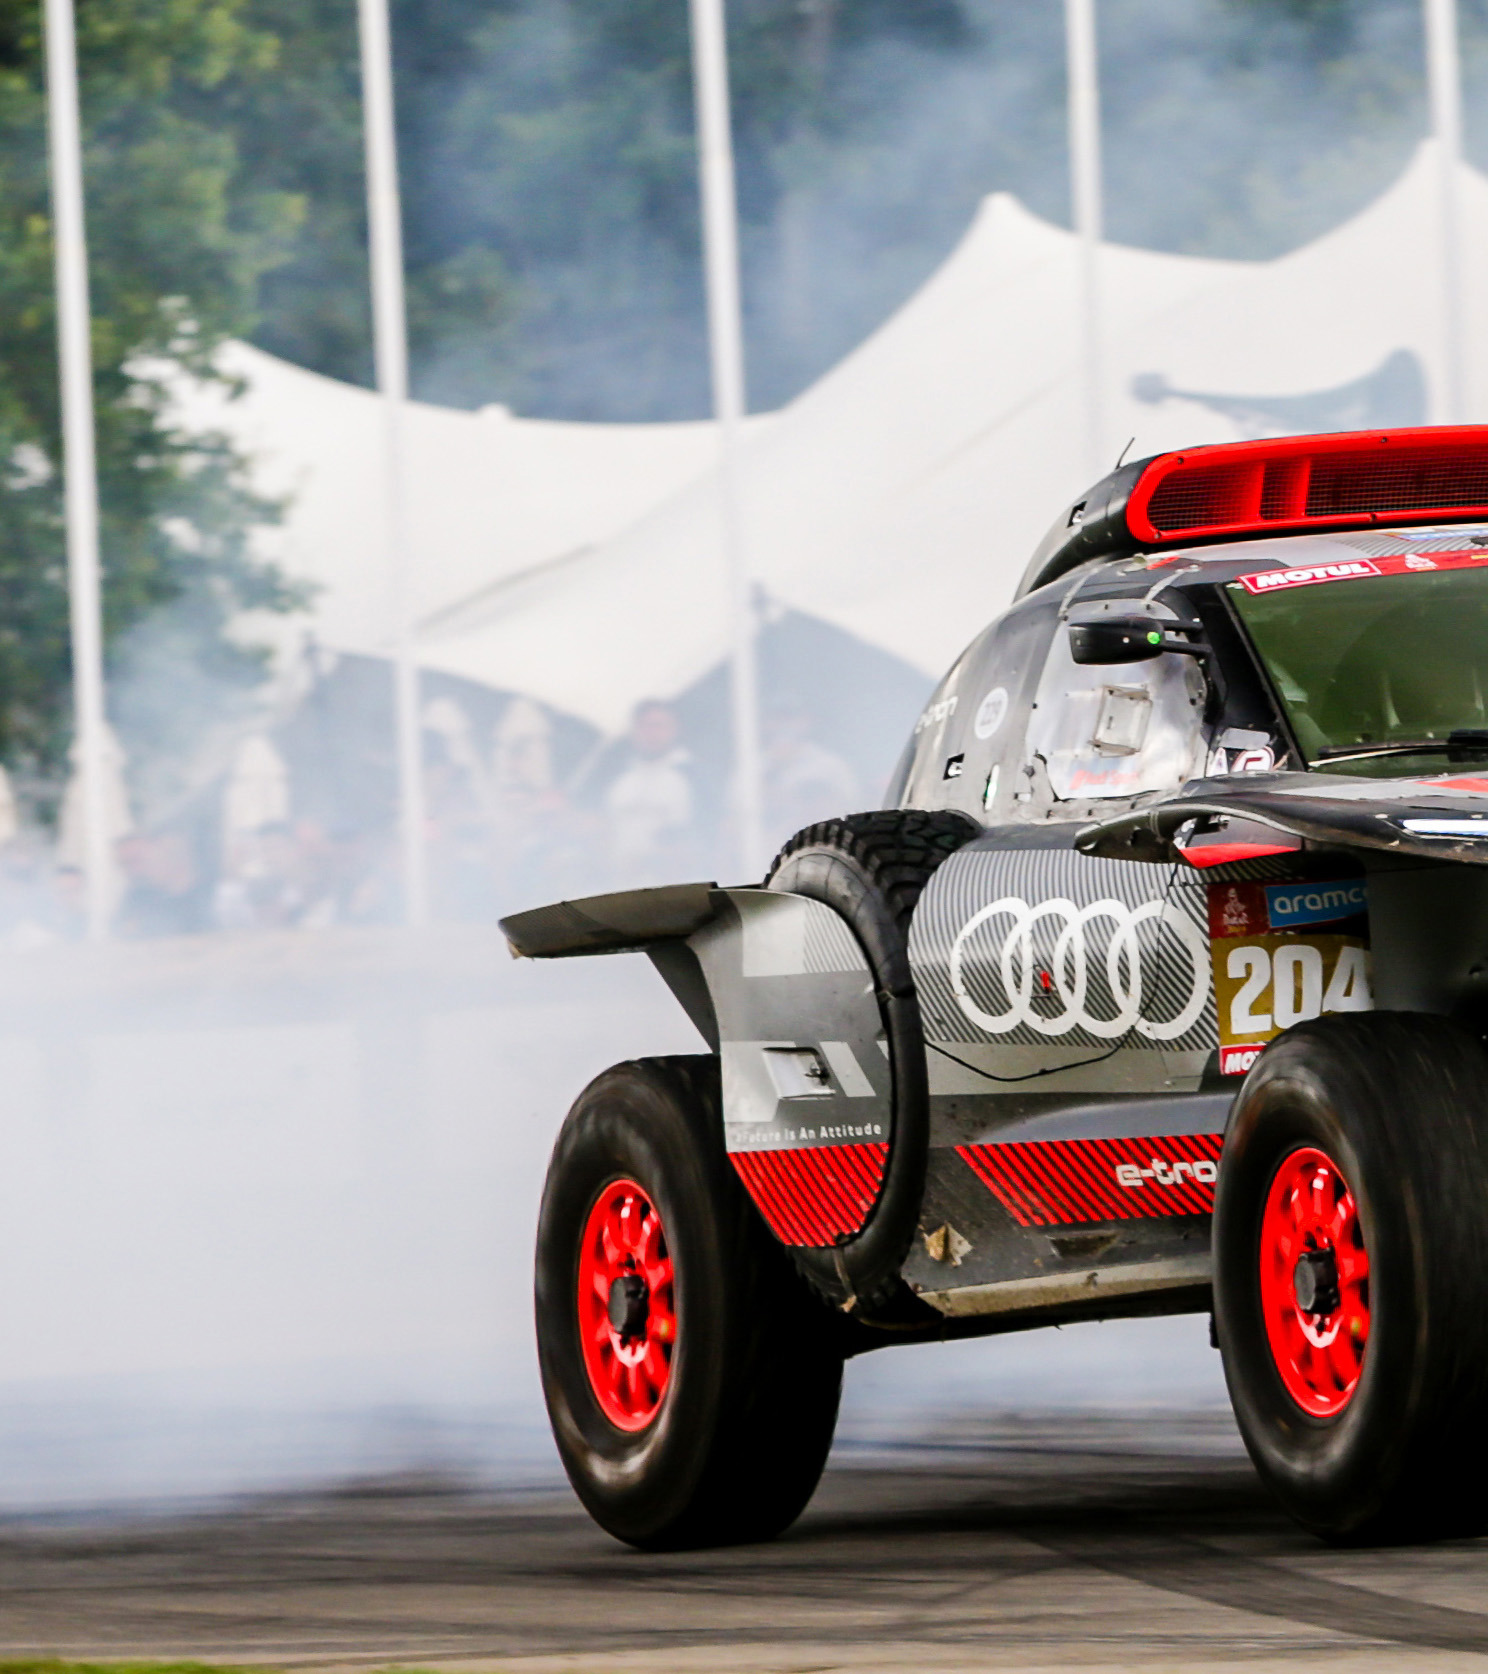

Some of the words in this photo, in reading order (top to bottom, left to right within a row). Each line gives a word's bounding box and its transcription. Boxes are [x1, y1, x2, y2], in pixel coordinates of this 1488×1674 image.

[1256, 562, 1371, 588] MOTUL
[1227, 944, 1374, 1035] 204
[1225, 1050, 1260, 1075] MO
[799, 1126, 817, 1141] An
[819, 1122, 882, 1139] Attitude
[1115, 1158, 1218, 1187] e-tro
